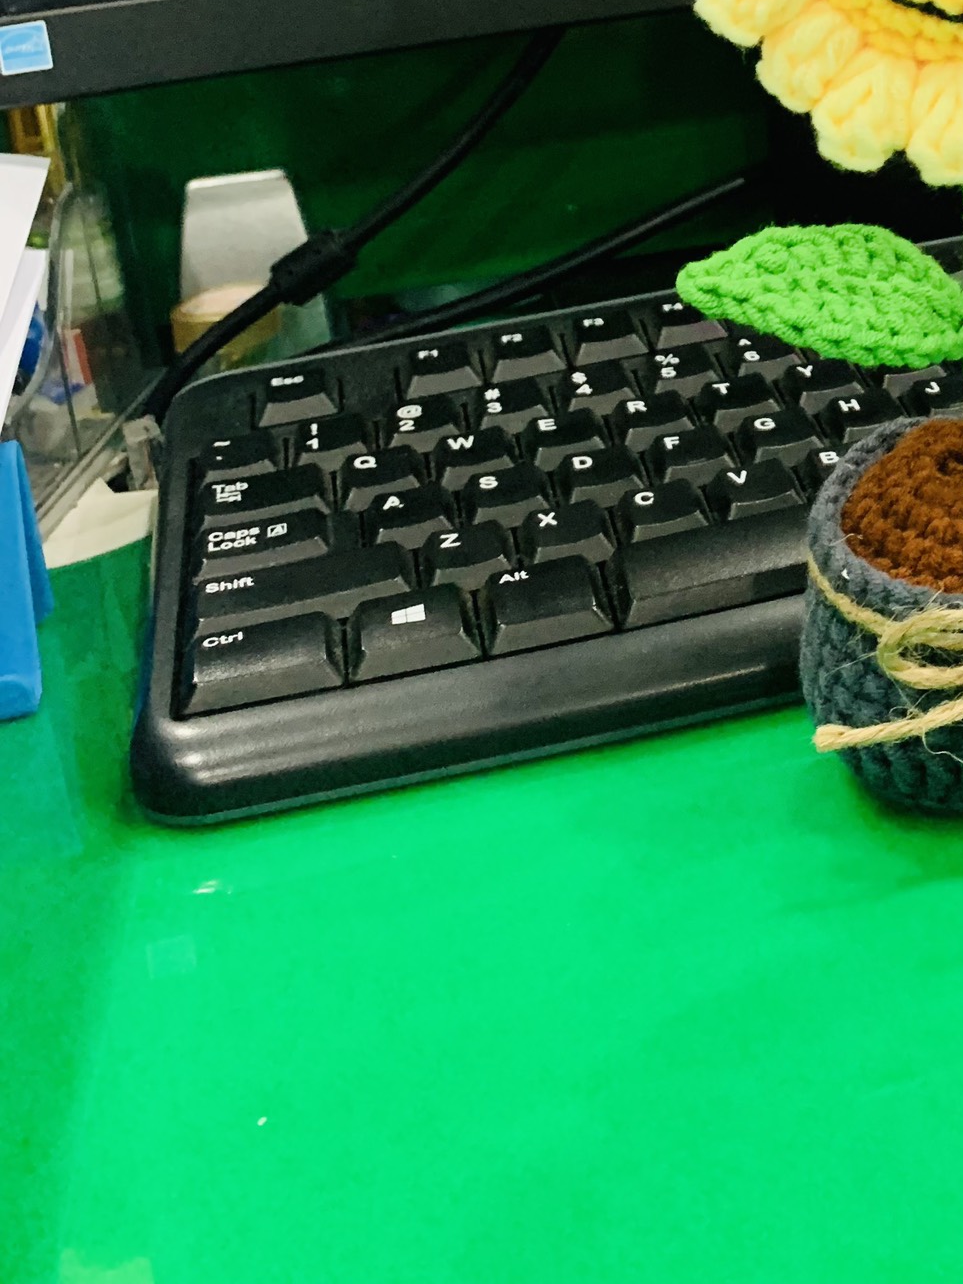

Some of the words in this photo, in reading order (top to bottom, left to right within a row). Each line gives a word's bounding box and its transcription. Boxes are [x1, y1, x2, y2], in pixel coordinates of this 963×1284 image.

[418, 350, 438, 359] F1
[744, 351, 760, 361] 6
[661, 367, 676, 378] 5
[797, 362, 812, 377] Y
[271, 376, 303, 386] Esc
[925, 382, 940, 393] J
[576, 382, 592, 394] 4
[712, 383, 729, 394] T
[397, 405, 422, 418] @
[487, 402, 502, 413] 3
[627, 401, 647, 413] R
[839, 399, 860, 411] H
[399, 420, 415, 431] 2
[538, 419, 556, 431] E
[754, 418, 775, 430] G
[306, 438, 318, 449] 1
[447, 436, 474, 449] W
[664, 437, 679, 449] F
[354, 456, 377, 469] Q
[572, 456, 592, 469] D
[819, 451, 840, 465] B
[479, 476, 498, 489] S
[727, 470, 747, 483] V
[212, 481, 249, 495] Tab
[635, 492, 654, 505] C
[538, 512, 557, 527] X
[208, 526, 261, 542] Caps
[440, 533, 461, 548] Z
[207, 536, 258, 553] Lock
[499, 571, 529, 584] Alt
[207, 576, 254, 593] Shift
[203, 632, 243, 647] Ctrl
